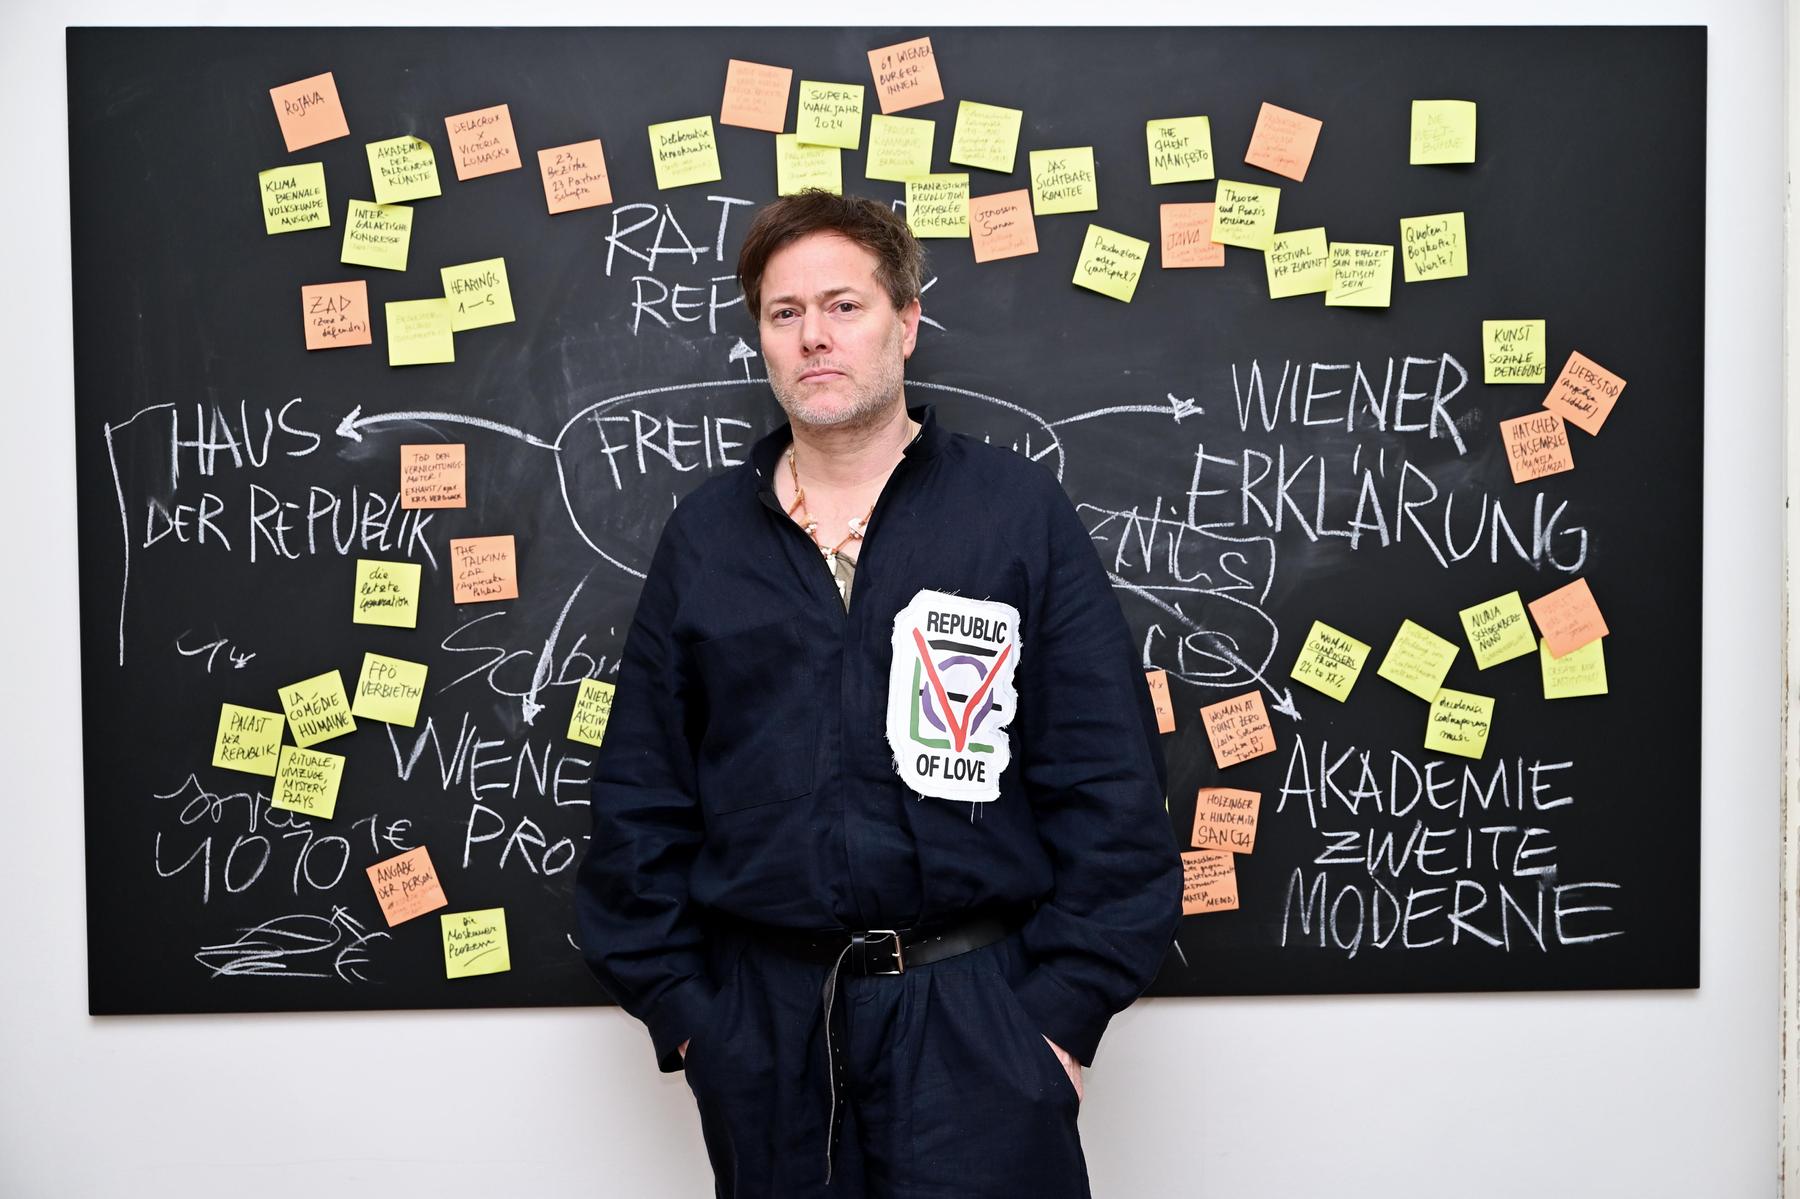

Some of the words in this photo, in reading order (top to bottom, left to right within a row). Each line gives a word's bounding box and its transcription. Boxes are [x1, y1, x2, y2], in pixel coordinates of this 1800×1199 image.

[887, 76, 918, 95] INNEN
[284, 91, 325, 117] ROJAVA
[815, 116, 843, 129] 2024
[1159, 127, 1177, 138] THE
[378, 142, 423, 159] AKADEMIE
[459, 137, 500, 154] VICTORIA
[1155, 137, 1190, 153] GHENT
[390, 156, 411, 166] DER
[463, 147, 510, 167] LOMASKO
[1047, 159, 1066, 173] DAS
[1154, 148, 1209, 171] MANIFESTO
[380, 159, 433, 177] BILDENDEN
[266, 177, 298, 192] KLIMA
[553, 179, 565, 193] 23
[1036, 171, 1093, 190] SICHTBARE
[275, 187, 321, 204] BIENNALE
[912, 191, 965, 202] REVOLUTION
[1042, 186, 1083, 202] KOMITEE
[268, 200, 324, 217] VOLKSKUNDE
[355, 208, 389, 219] INTER-
[281, 212, 320, 226] MUSEUM
[604, 195, 756, 277] RAT
[1271, 247, 1312, 264] FESTIVAL
[1274, 241, 1289, 252] DAS
[1333, 248, 1351, 258] NUR
[451, 270, 500, 294] HEARINGS
[1335, 270, 1375, 280] POLITISCH
[1341, 281, 1364, 289] SEIN
[310, 295, 351, 314] ZAD
[1494, 324, 1534, 343] KUNST
[1500, 344, 1514, 352] ALS
[1489, 352, 1534, 364] SOZIALE
[1568, 360, 1619, 398] LIEBESTOD
[1232, 352, 1468, 455] WIENER
[1512, 416, 1559, 441] HATCHED
[171, 398, 321, 490] HAUS
[587, 409, 752, 490] FREIE
[1512, 432, 1566, 459] ENSEMBLE
[413, 453, 430, 463] TOD
[1186, 444, 1588, 574] ERKLÄRUNG
[143, 493, 231, 553] DER
[250, 484, 438, 571] REPUBLIK
[454, 545, 477, 556] THE
[462, 553, 508, 567] TALKING
[369, 566, 388, 580] die
[459, 568, 484, 579] CAR
[1472, 606, 1501, 627] NURIA
[927, 611, 1007, 643] REPUBLIC
[1320, 631, 1352, 653] WOMAN
[1307, 640, 1356, 670] COMPOSERS
[1315, 654, 1338, 670] FROM
[369, 661, 397, 679] FPÖ
[289, 692, 304, 706] LA
[361, 682, 421, 699] VERBIETEN
[289, 692, 340, 721] COMÉDIE
[577, 699, 594, 709] MIT
[1209, 703, 1242, 723] WOMAN
[1244, 700, 1254, 712] AT
[230, 711, 272, 734] PALAST
[298, 711, 350, 738] HUMAINE
[1211, 718, 1236, 734] POINT
[1239, 714, 1260, 728] ZERO
[222, 732, 240, 746] DER
[220, 743, 277, 762] REPUBLIK
[288, 751, 336, 769] RITUALE,
[386, 711, 592, 807] WIENE
[916, 753, 940, 777] OF
[943, 757, 986, 783] LOVE
[283, 779, 327, 796] MYSTERY
[1276, 734, 1573, 828] AKADEMIE
[282, 789, 314, 809] PLAYS
[1207, 793, 1253, 810] HOLZINGER
[460, 803, 592, 875] PRO
[1314, 820, 1558, 878] ZWEITE
[377, 858, 415, 884] ANGABE
[378, 883, 400, 900] DER
[1281, 866, 1625, 959] MODERNE
